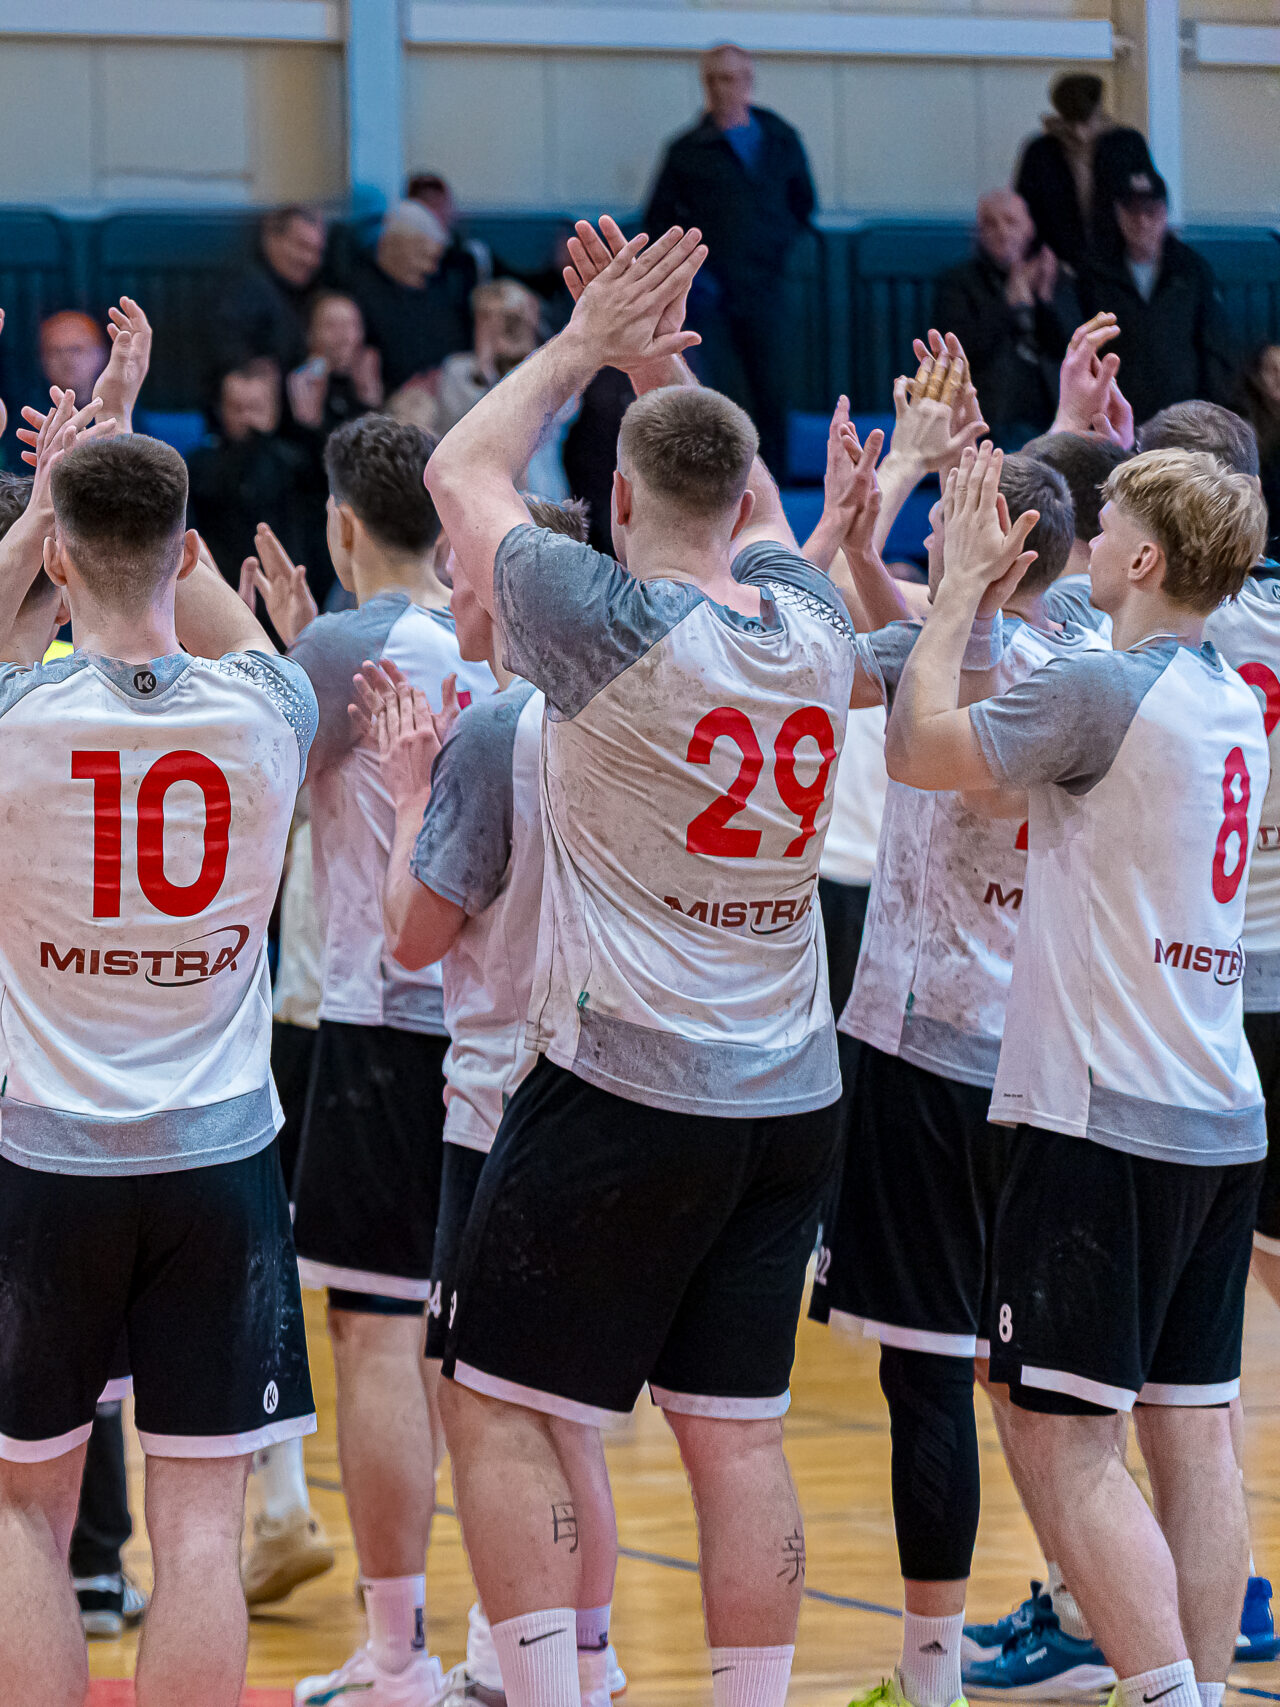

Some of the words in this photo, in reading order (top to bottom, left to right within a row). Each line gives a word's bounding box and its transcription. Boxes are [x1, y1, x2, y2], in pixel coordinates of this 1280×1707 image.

[686, 706, 837, 858] 29
[71, 750, 231, 917] 10
[1212, 747, 1250, 904] 8
[664, 892, 814, 931] MISTRA
[40, 938, 240, 980] MISTRA
[1154, 938, 1244, 979] MISTR
[999, 1303, 1013, 1343] 8
